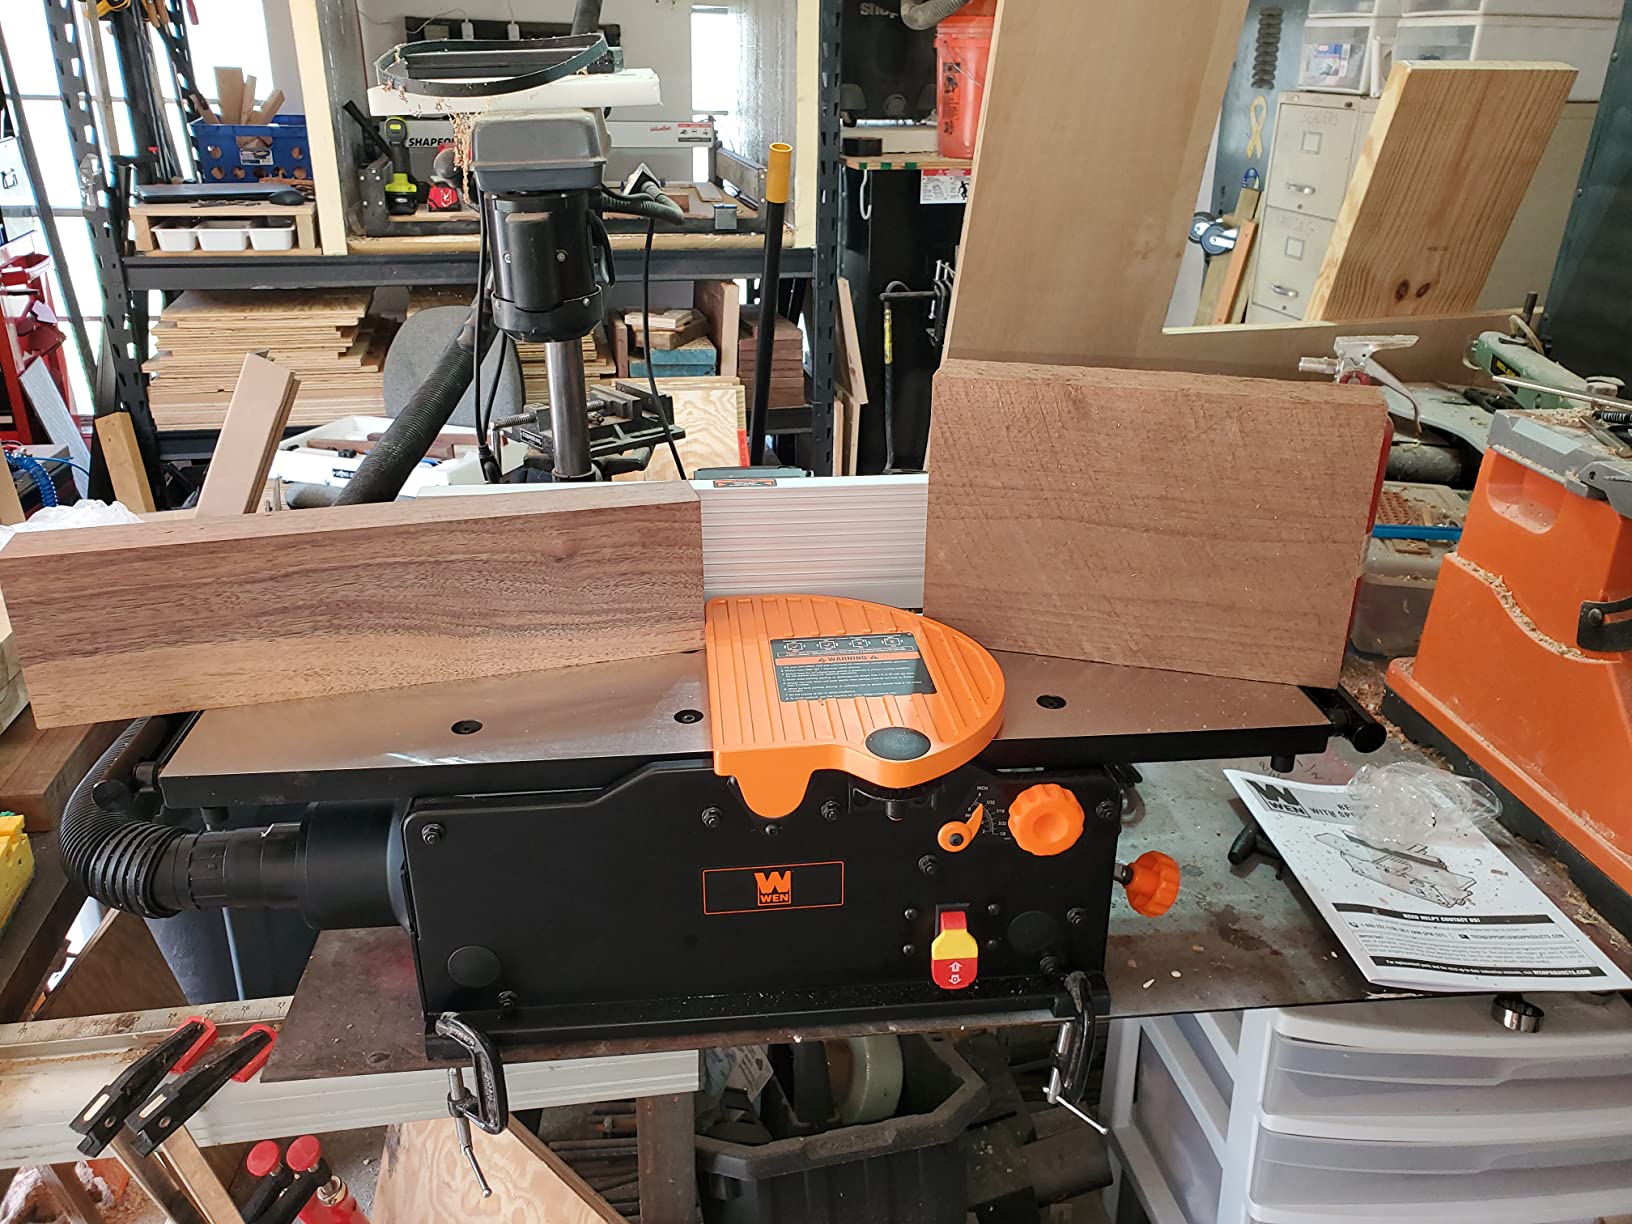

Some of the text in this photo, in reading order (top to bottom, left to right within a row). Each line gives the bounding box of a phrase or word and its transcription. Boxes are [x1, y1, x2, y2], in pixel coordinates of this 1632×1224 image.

[1268, 800, 1306, 815] WEN
[1309, 807, 1336, 818] WITH
[760, 893, 789, 903] WEN
